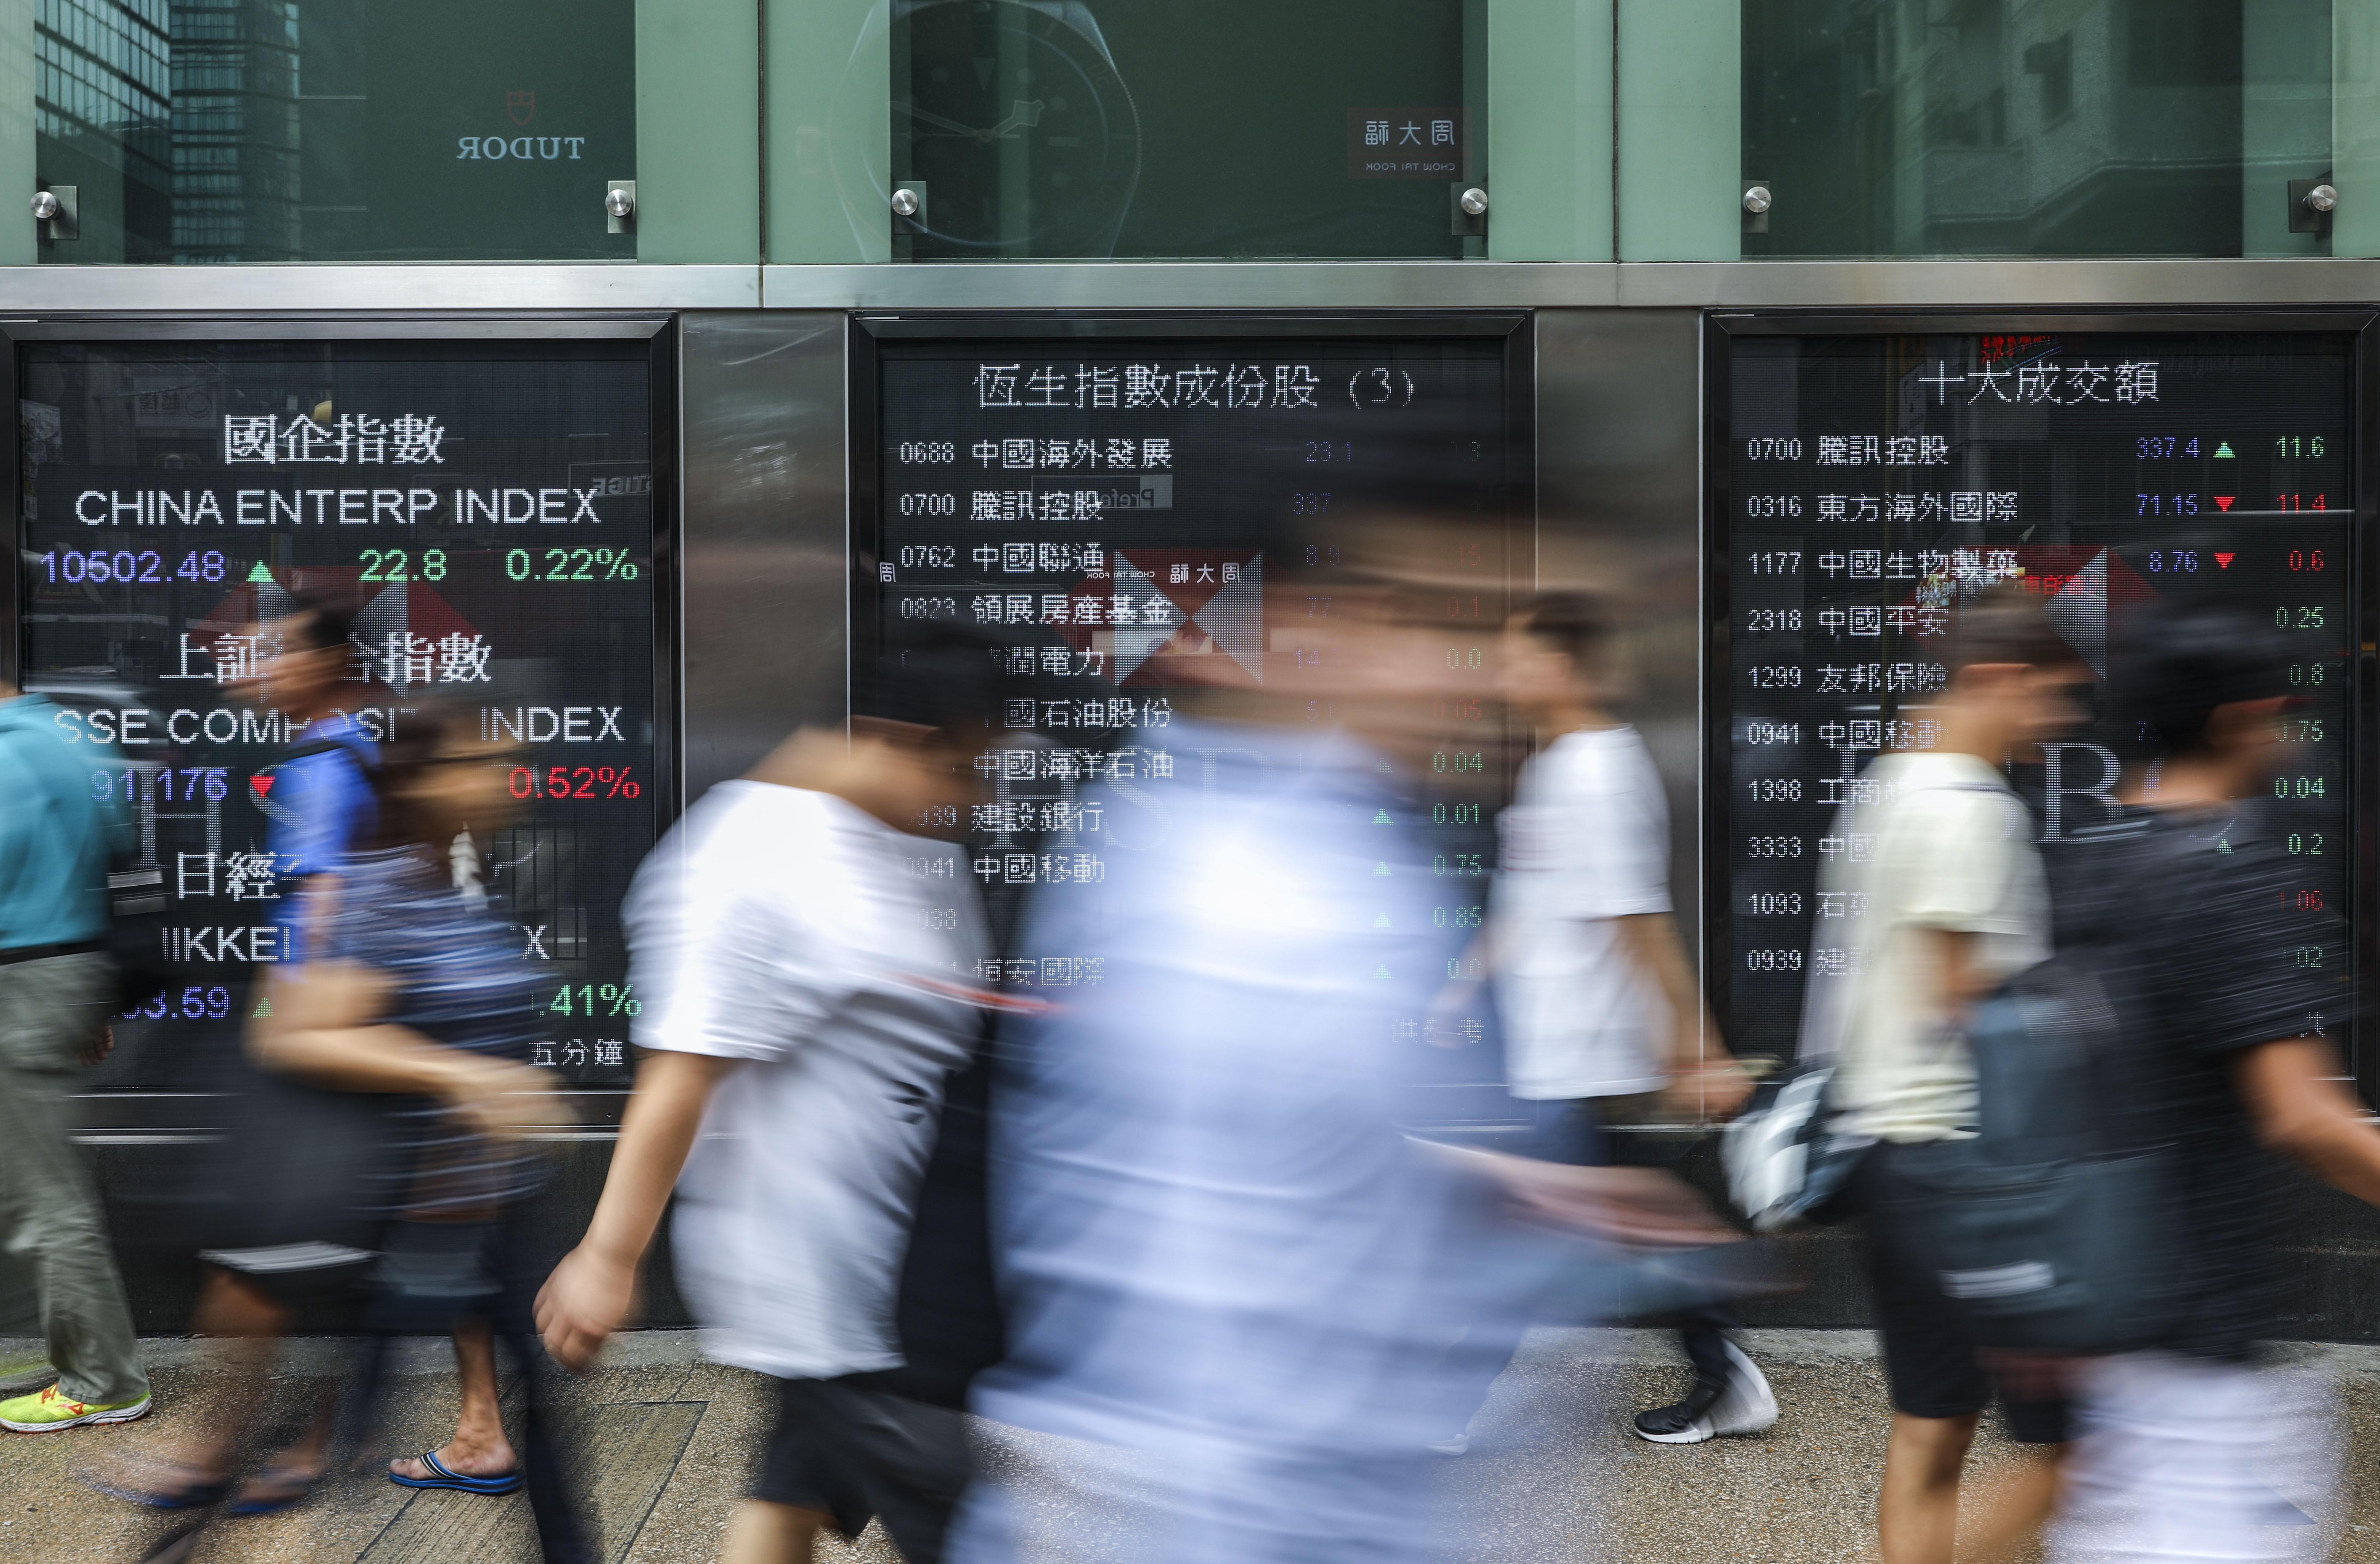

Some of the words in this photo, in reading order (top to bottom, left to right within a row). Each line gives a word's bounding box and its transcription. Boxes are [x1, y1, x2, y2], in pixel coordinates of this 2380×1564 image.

[1349, 368, 1414, 409] (3)
[1918, 360, 2159, 405] 十大成交額
[224, 413, 446, 465] 國企指數
[900, 441, 955, 464] 0688
[971, 439, 1173, 469] 中國海外發展
[1747, 438, 1803, 461] 0700
[1817, 435, 1950, 466] 騰訊控股
[2136, 437, 2200, 458] 337.4
[2276, 435, 2325, 458] 11.6
[75, 490, 225, 526] CHINA
[236, 489, 438, 525] ENTERP
[454, 488, 602, 524] INDEX
[900, 493, 955, 516] 0700
[970, 490, 1104, 520] 騰訊控股
[1292, 493, 1348, 514] 337.
[1747, 495, 1803, 517] 0316
[1817, 492, 2018, 522] 東方海外國際
[2136, 494, 2199, 516] 71.15
[2276, 493, 2326, 514] 11.4
[40, 551, 226, 583] 10502.48
[359, 549, 447, 582] 22.8
[505, 548, 638, 581] 0.22%
[900, 545, 956, 567] 0762
[972, 542, 1104, 572] 中國聯通
[1747, 551, 1803, 574] 1177
[1819, 549, 2018, 580] 中國生物製藥
[2149, 550, 2199, 573] 8.76
[2288, 549, 2324, 571] 0.6
[971, 594, 1173, 624] 領展房產基金
[1747, 609, 1803, 631] 2318
[1819, 606, 1949, 636] 中國平安
[2276, 607, 2324, 629] 0.25
[988, 646, 1104, 676] 潤電力
[1446, 647, 1482, 670] 0.0
[1747, 665, 1803, 688] 1299
[1817, 663, 1949, 693] 友邦保險
[2289, 664, 2324, 685] 0.8
[53, 708, 150, 744] SSE
[479, 706, 626, 742] INDEX
[1003, 698, 1174, 728] 國石油股份
[1747, 722, 1801, 744] 0941
[1819, 719, 1949, 749] 中國移動
[974, 749, 1174, 780] 中國海洋石油
[1433, 750, 1484, 773] 0.04
[82, 768, 228, 801] 91.176
[510, 766, 640, 799] 0.52%
[1747, 779, 1803, 801] 1398
[1817, 776, 1904, 807] 工商
[2275, 776, 2326, 798] 0.04
[971, 802, 1105, 832] 建設銀行
[1433, 802, 1480, 825] 0.01
[1747, 836, 1803, 858] 3333
[2288, 833, 2323, 855] 0.2
[974, 854, 1105, 883] 中國移動
[1433, 855, 1482, 877] 0.75
[918, 908, 957, 930] 038
[1433, 906, 1482, 927] 0.85
[1747, 893, 1803, 915] 1093
[1747, 949, 1803, 971] 0939
[530, 983, 643, 1017] .41%
